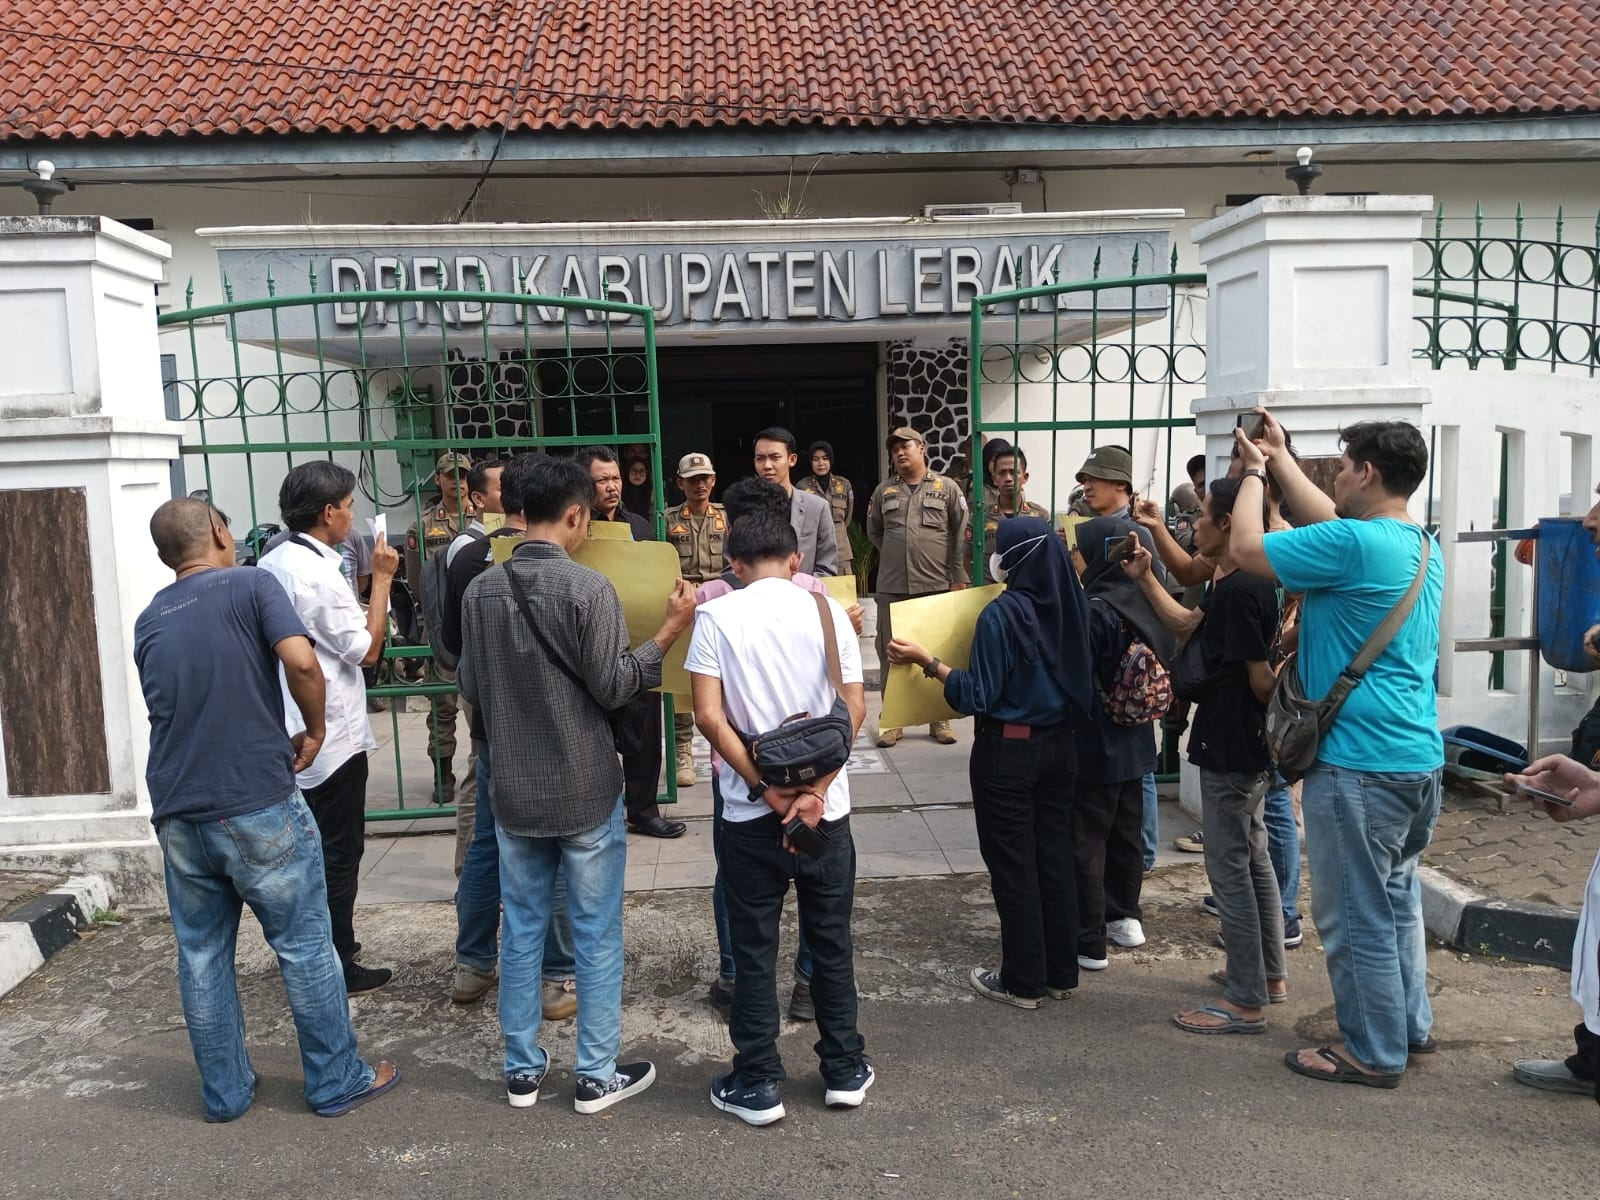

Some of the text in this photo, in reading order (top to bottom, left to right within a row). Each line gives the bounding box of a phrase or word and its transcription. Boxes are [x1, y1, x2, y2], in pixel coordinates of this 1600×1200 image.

[330, 243, 1068, 326] DPRD KABUPATEN LEBAK
